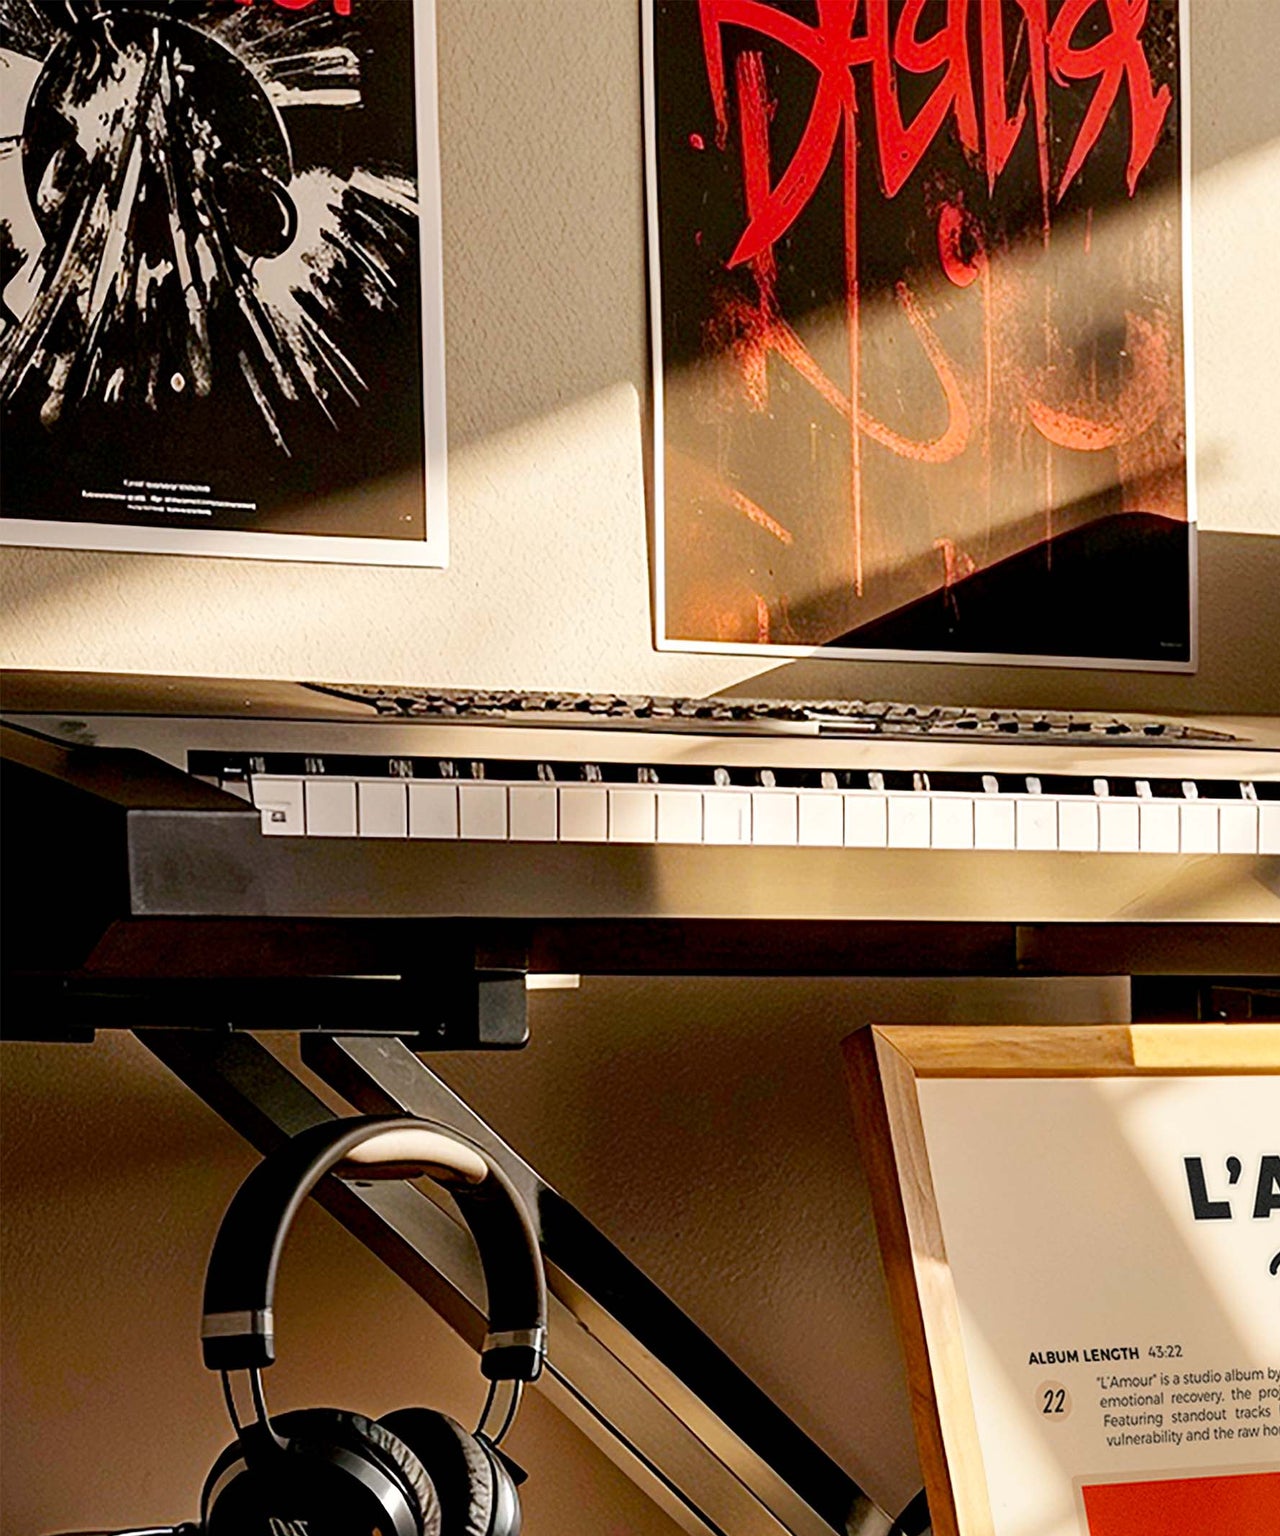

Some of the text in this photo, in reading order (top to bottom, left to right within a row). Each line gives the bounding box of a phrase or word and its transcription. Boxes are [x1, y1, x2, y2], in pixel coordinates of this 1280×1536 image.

[1028, 1344, 1183, 1365] ALBUM LENGTH 43:22
[1043, 1389, 1065, 1413] 22
[1106, 1429, 1183, 1447] vulnerability
[1185, 1427, 1210, 1442] and
[1213, 1426, 1234, 1440] the
[1237, 1427, 1260, 1438] raw
